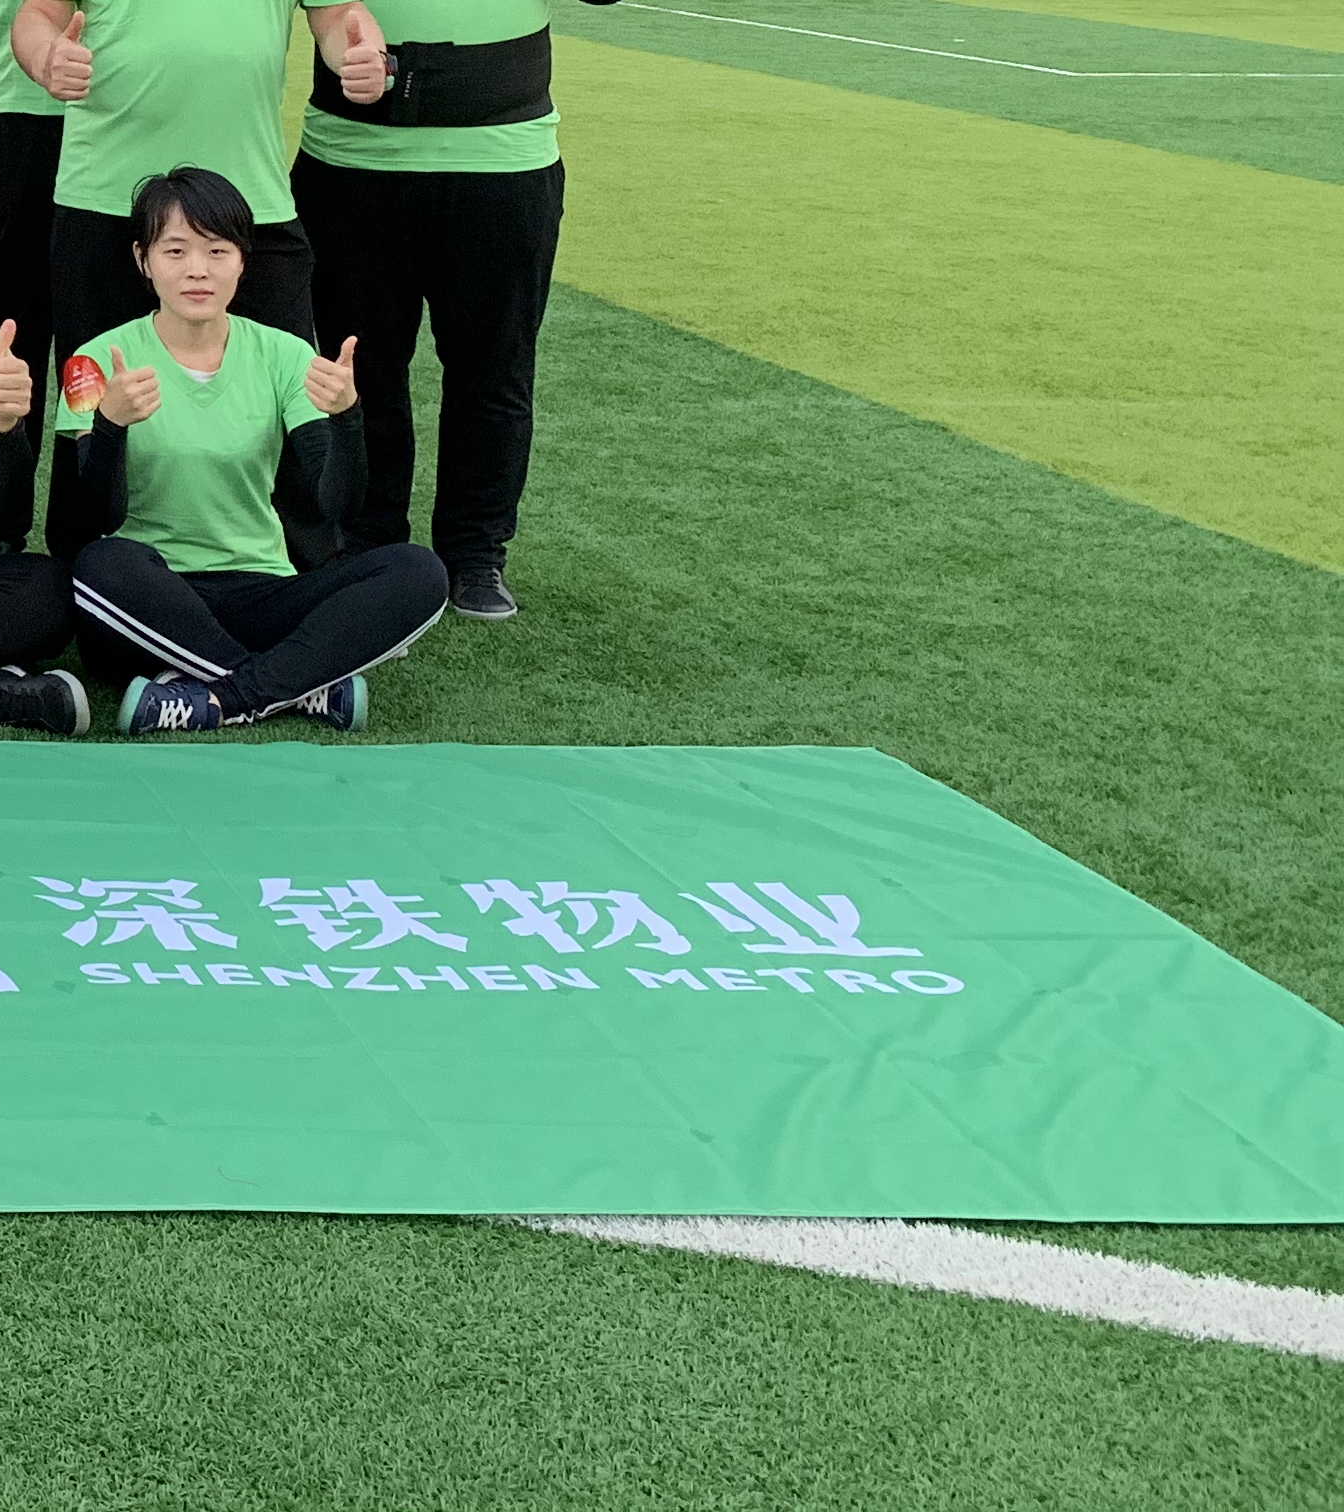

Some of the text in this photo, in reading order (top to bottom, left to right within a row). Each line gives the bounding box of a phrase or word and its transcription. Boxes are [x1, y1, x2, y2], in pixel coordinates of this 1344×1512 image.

[31, 875, 922, 958] 深铁物业
[78, 962, 966, 996] SHENZHEN METRO
